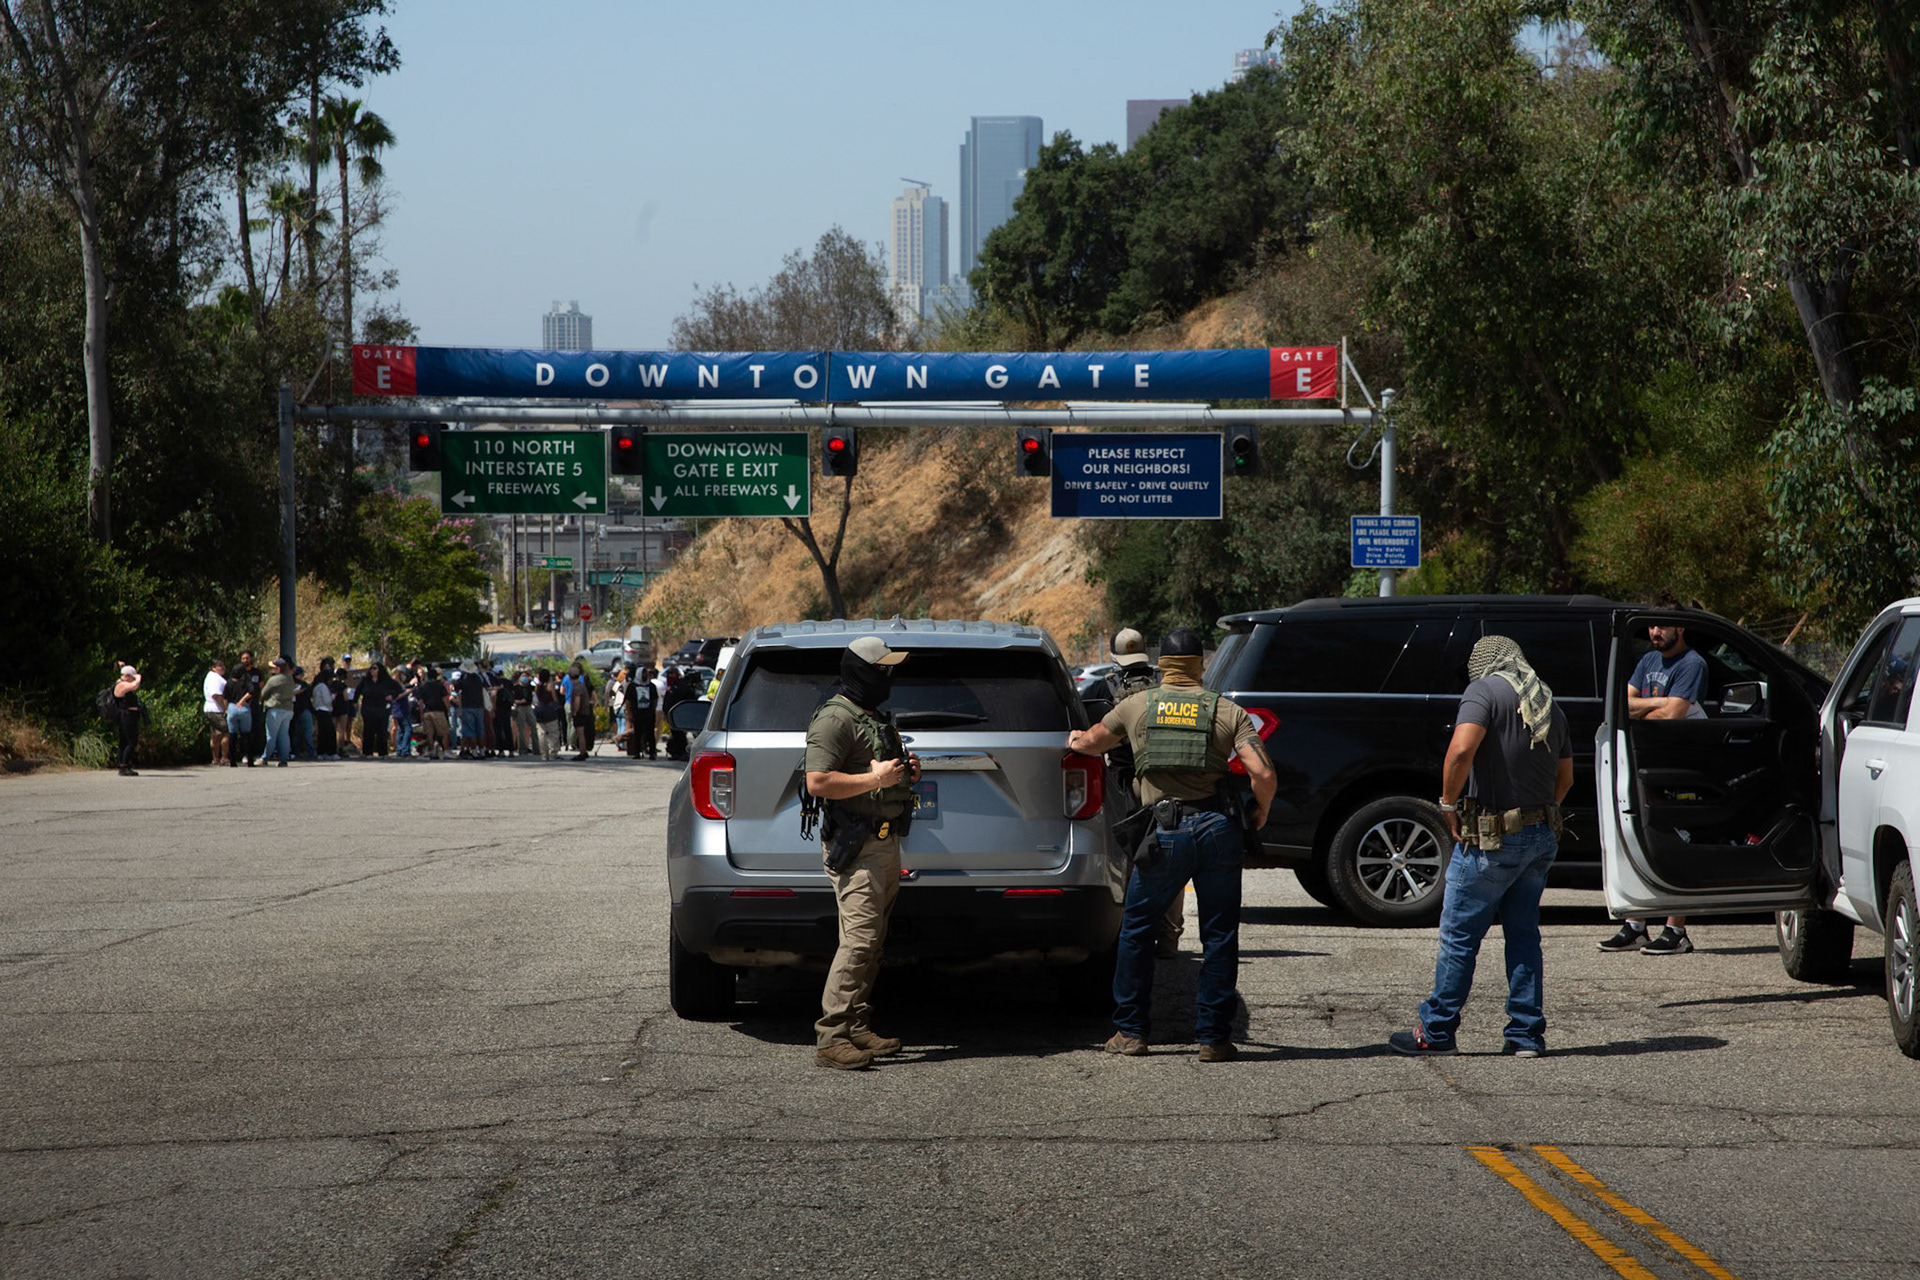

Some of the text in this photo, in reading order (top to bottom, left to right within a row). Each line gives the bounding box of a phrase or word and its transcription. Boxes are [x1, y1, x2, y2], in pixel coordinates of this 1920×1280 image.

[362, 350, 402, 359] GATE
[1281, 351, 1323, 362] GATE
[377, 365, 391, 389] E
[536, 363, 1150, 389] DOWNTOWN GATE
[1296, 367, 1312, 392] E
[473, 440, 575, 455] 110 NORTH
[667, 442, 783, 457] DOWNTOWN
[1088, 448, 1185, 459] PLEASE RESPECT
[465, 461, 582, 476] INTERSTATE 5
[673, 463, 779, 478] GATE E EXIT
[1082, 463, 1190, 475] OUR NEIGHBORS!
[487, 482, 560, 495] FREEWAYS
[673, 484, 778, 496] ALL FREEWAYS
[1064, 481, 1209, 490] DRIVE SAFELY DRIVE QUIETLY
[1100, 494, 1173, 504] DO NOT LITTER
[1356, 519, 1416, 527] THANKS FOR COMING
[1355, 528, 1417, 536] AND PLEASE RESPECT
[1357, 538, 1371, 546] OUR
[1157, 701, 1199, 717] POLICE
[1164, 716, 1180, 724] BORDER
[1181, 717, 1196, 726] PATROL
